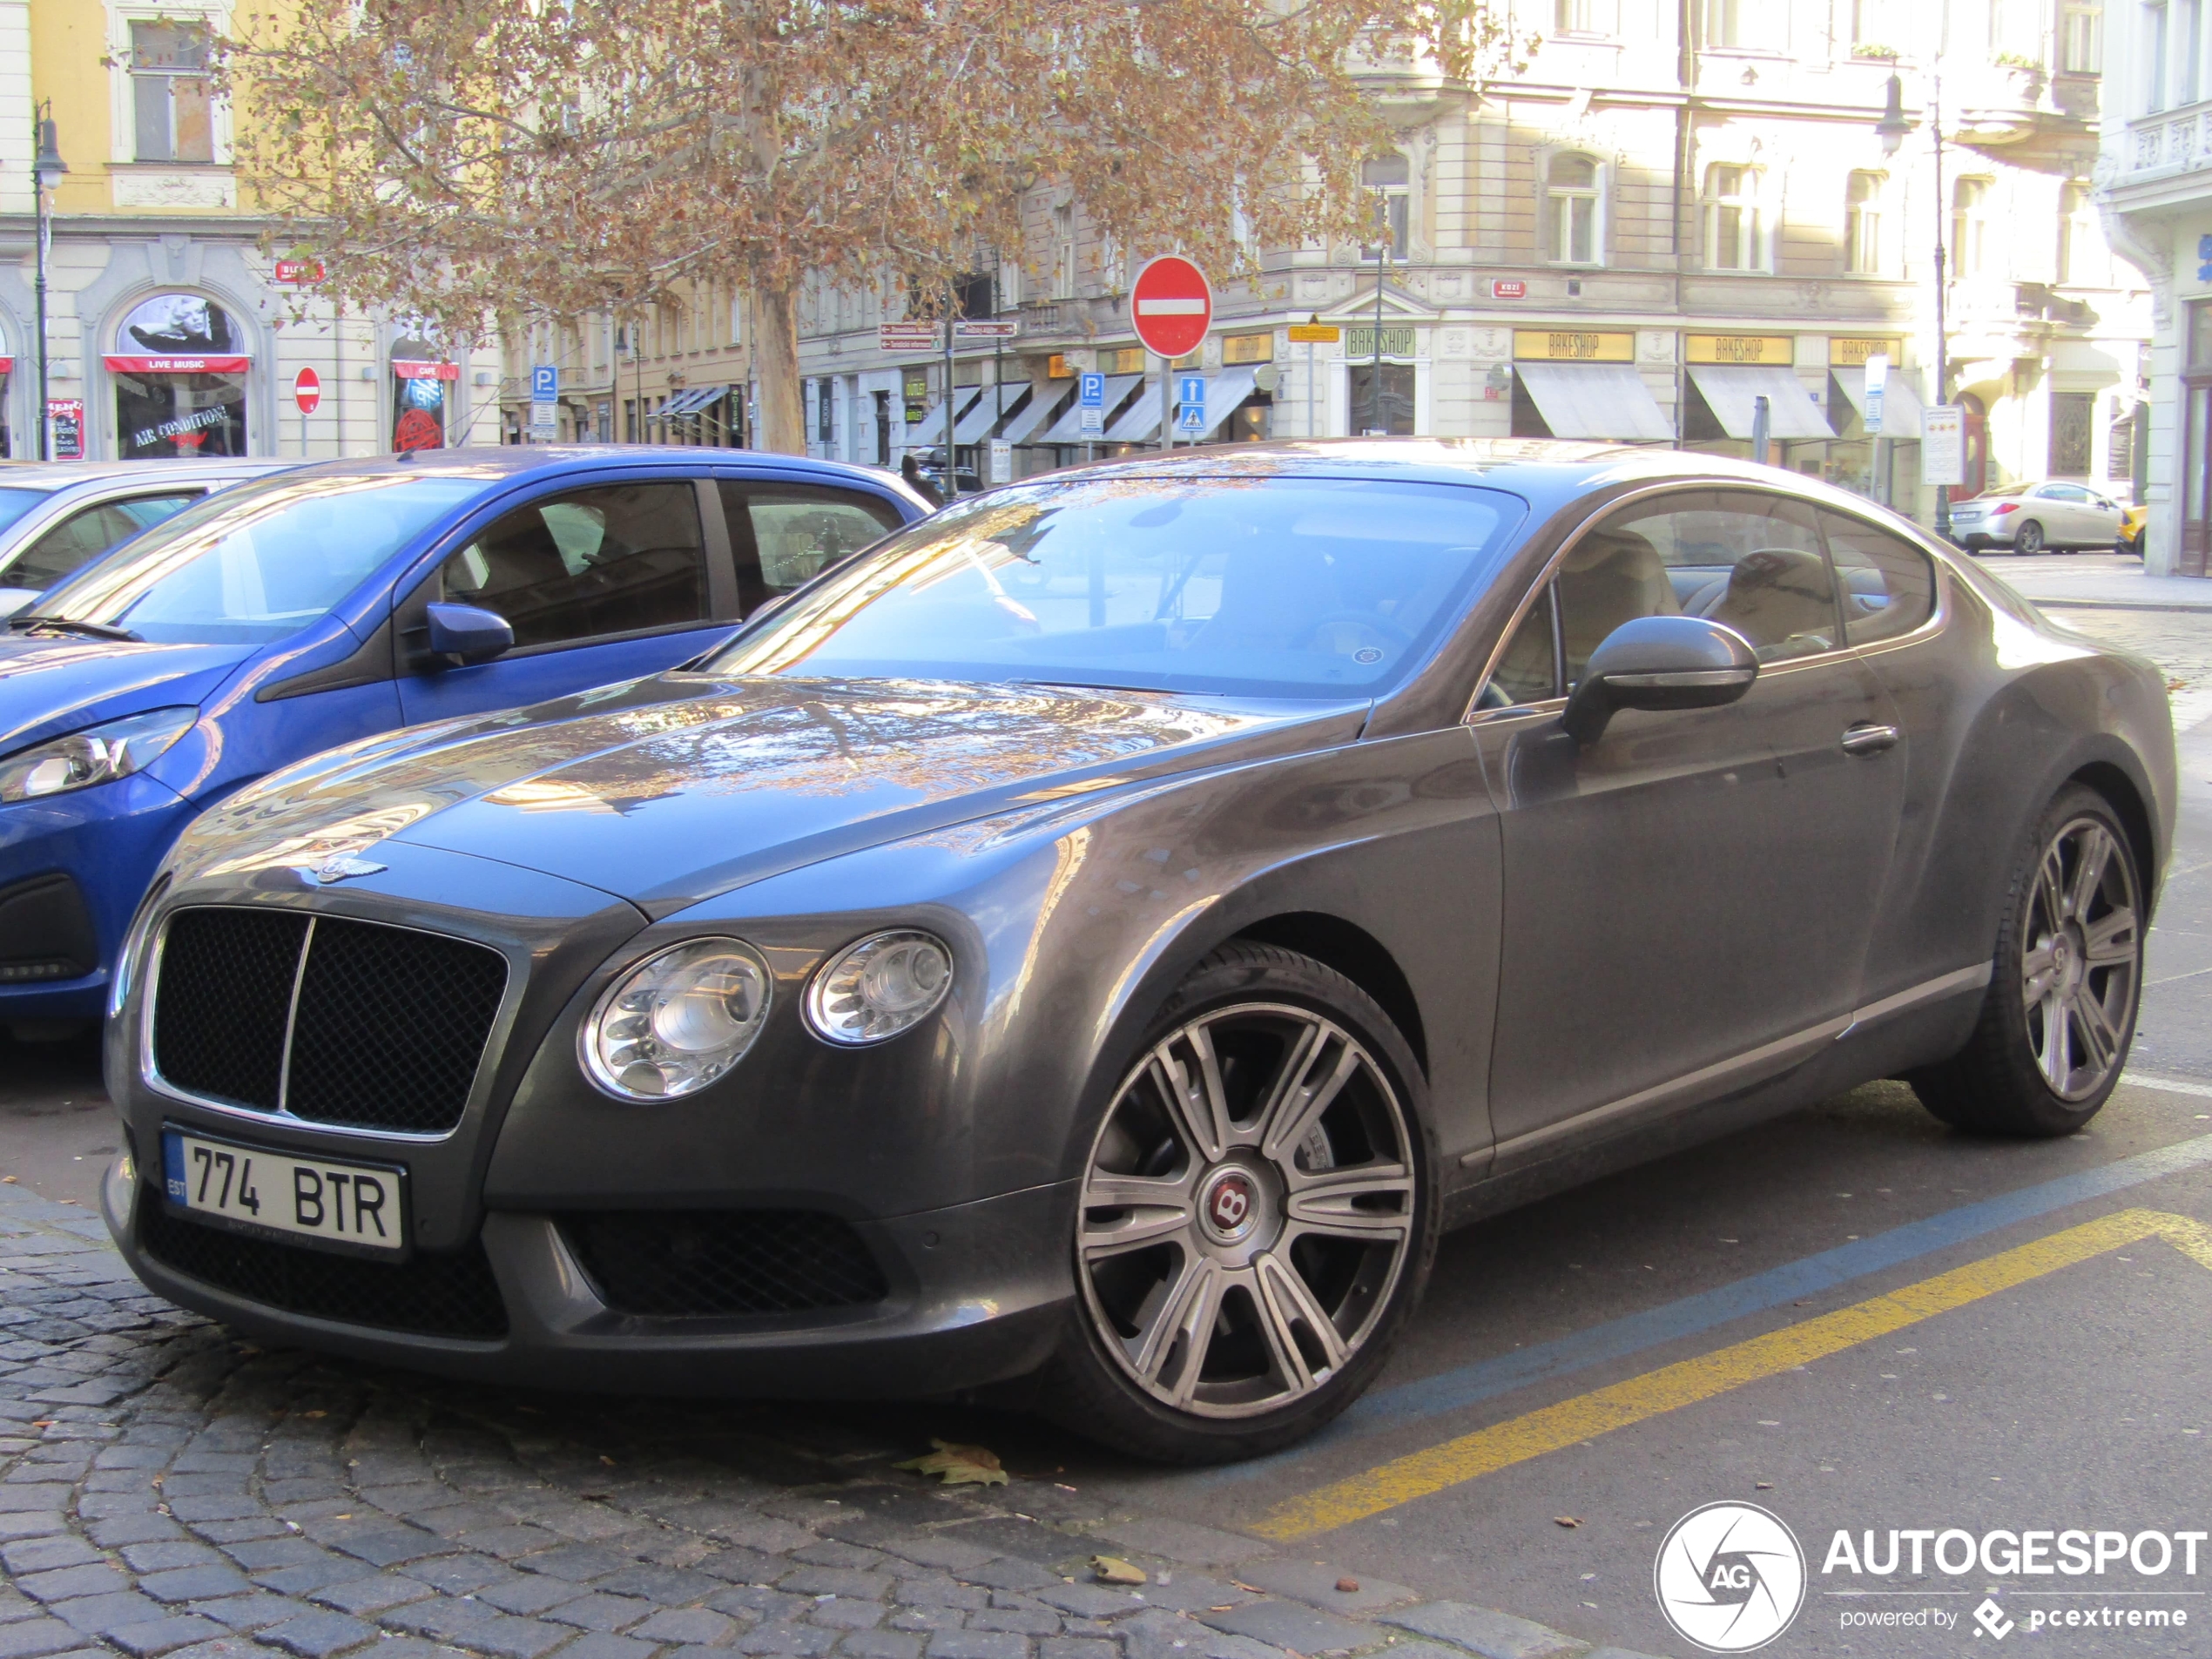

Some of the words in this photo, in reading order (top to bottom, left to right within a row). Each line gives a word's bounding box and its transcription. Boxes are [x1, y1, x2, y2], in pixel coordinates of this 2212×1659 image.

[1350, 329, 1412, 354] BAKSHOP
[1548, 334, 1599, 358] BAKESHOP
[1716, 338, 1764, 361] BAKESHOP
[419, 367, 436, 375] CAFE
[135, 428, 158, 448] AIR
[158, 405, 229, 439] CONDITION!
[166, 1178, 185, 1197] EST
[193, 1145, 260, 1217] 774
[293, 1165, 387, 1238] BTR
